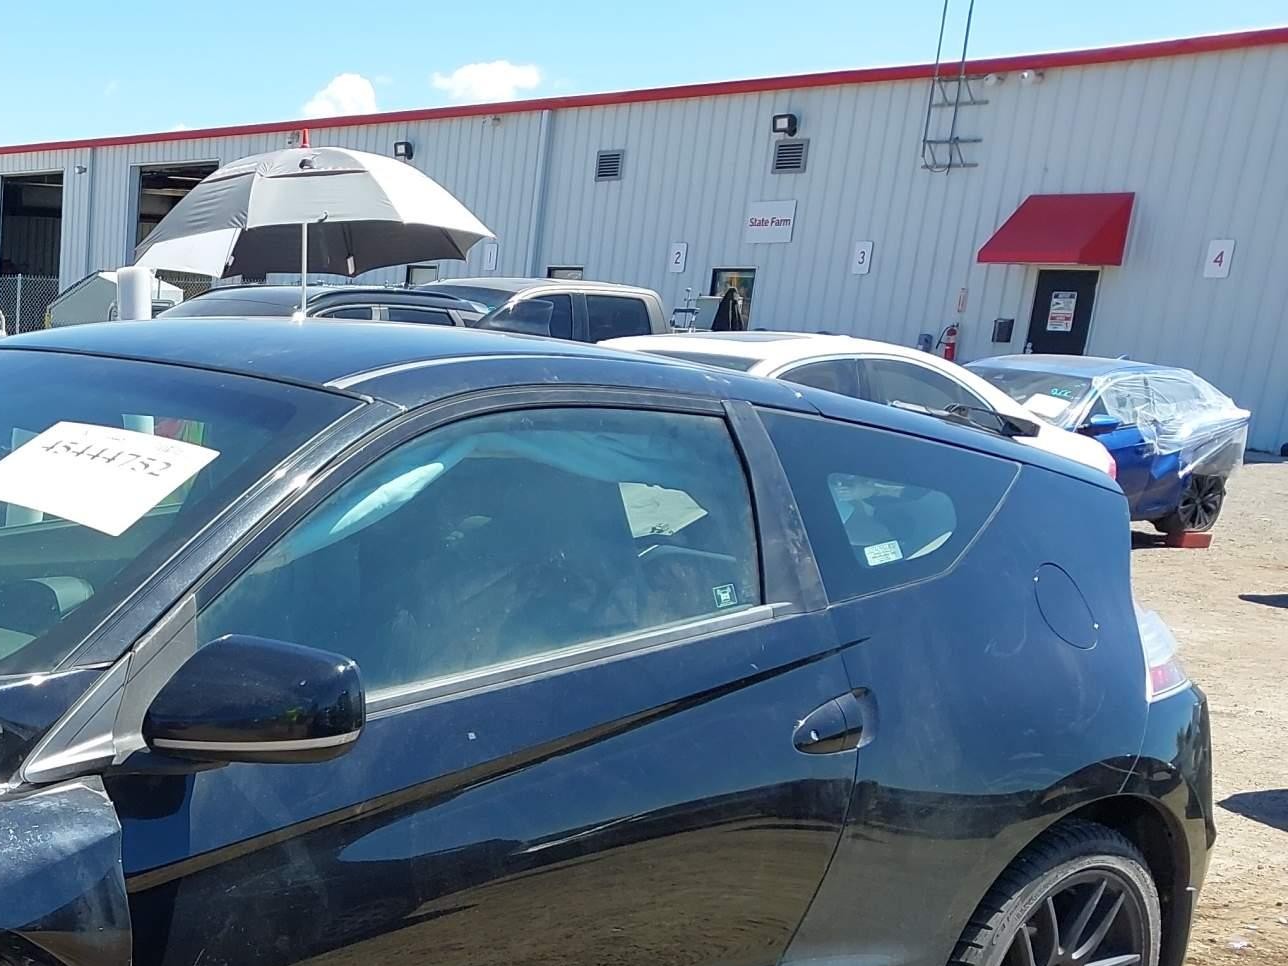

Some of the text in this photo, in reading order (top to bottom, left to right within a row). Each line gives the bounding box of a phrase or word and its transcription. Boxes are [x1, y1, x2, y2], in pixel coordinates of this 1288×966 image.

[749, 216, 791, 226] State Farm
[674, 251, 681, 264] 2
[857, 250, 865, 264] 3
[1212, 250, 1224, 267] 4
